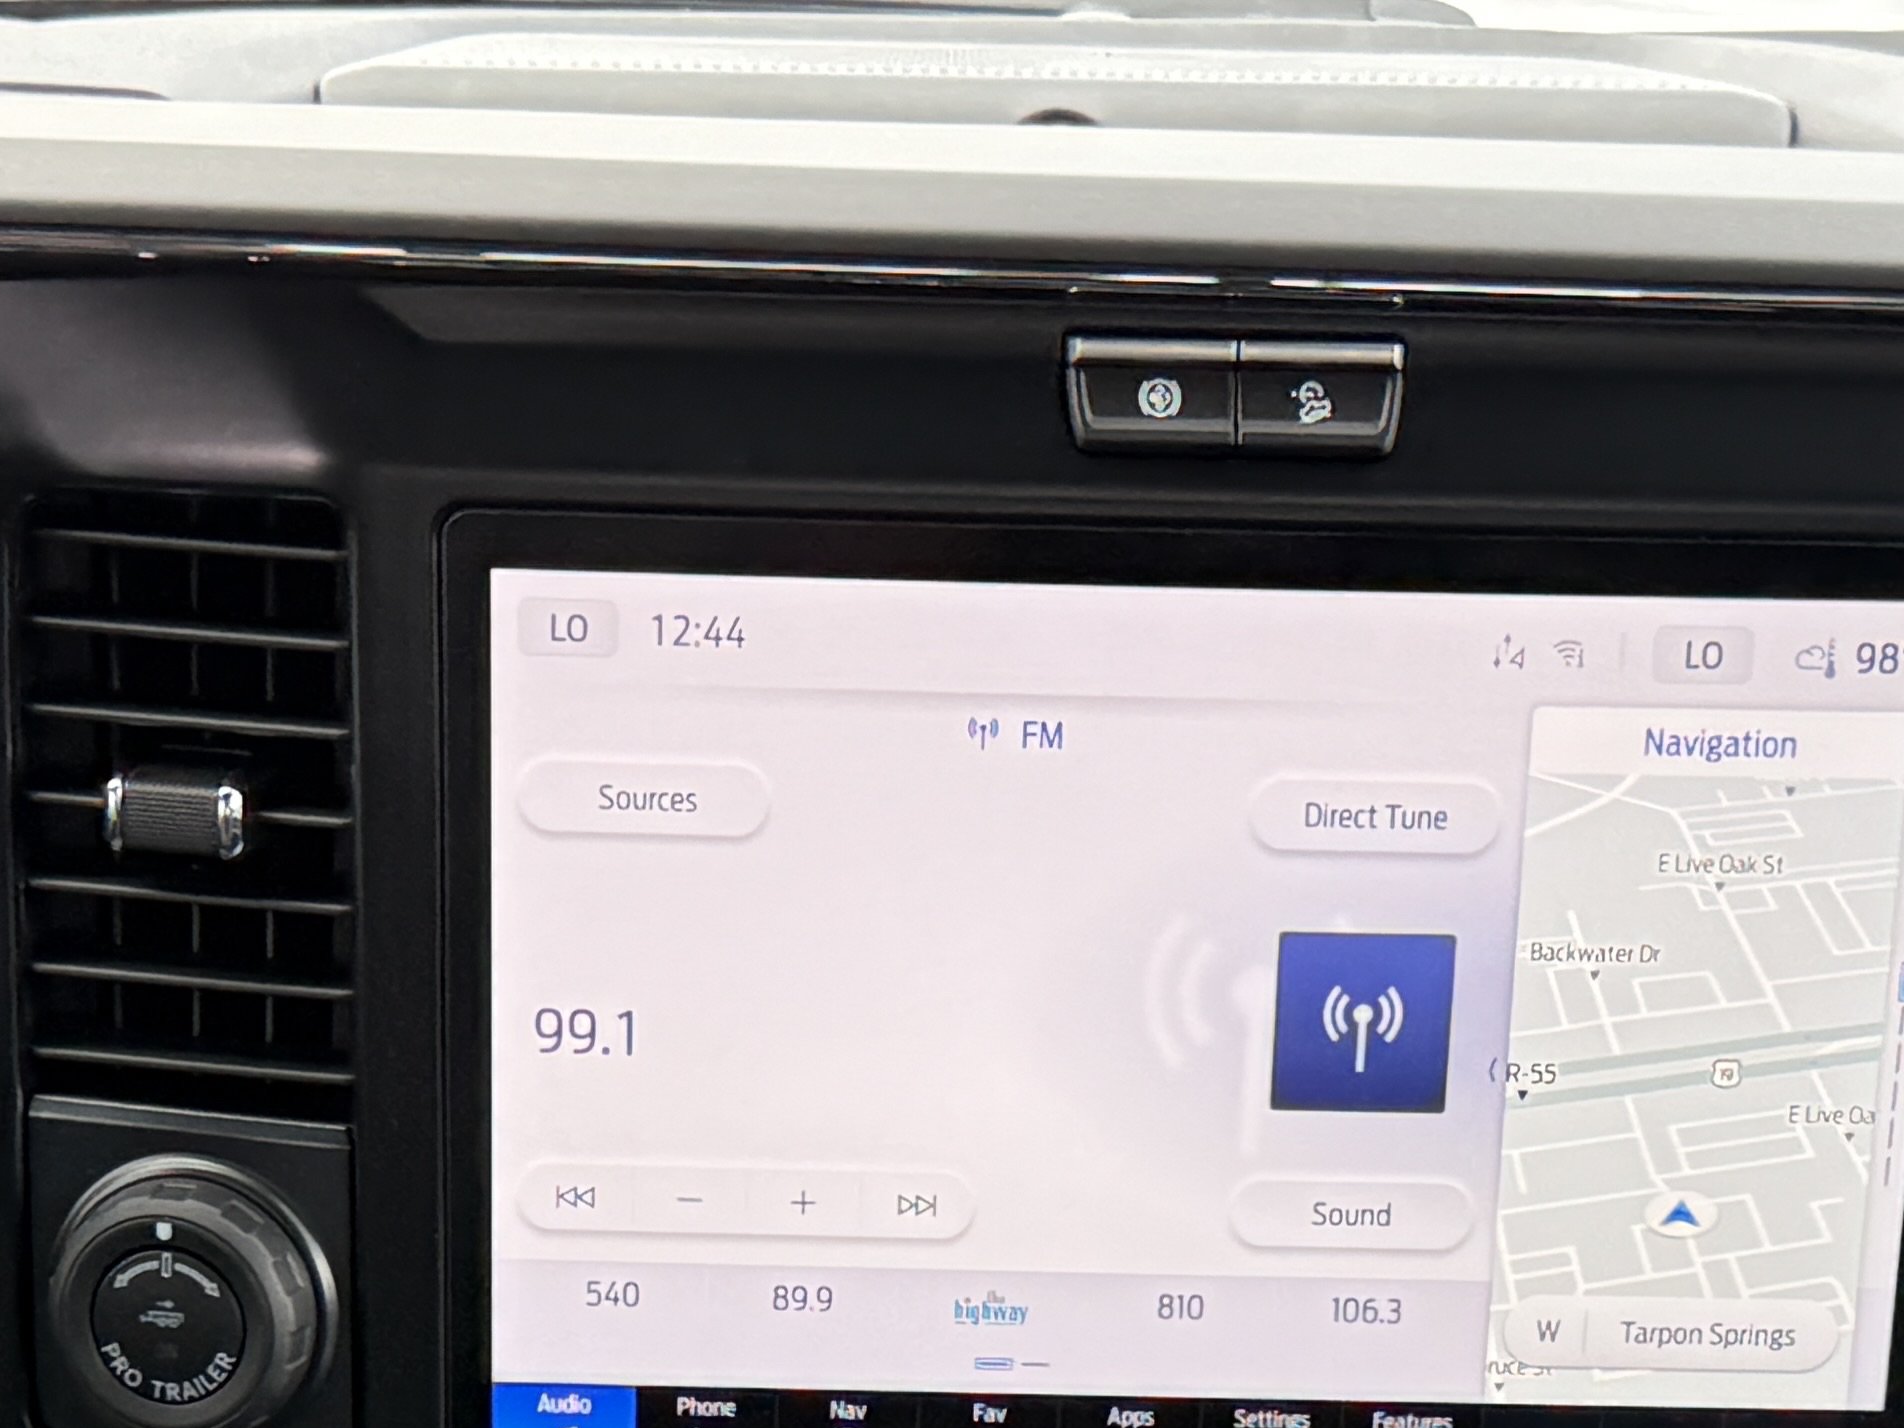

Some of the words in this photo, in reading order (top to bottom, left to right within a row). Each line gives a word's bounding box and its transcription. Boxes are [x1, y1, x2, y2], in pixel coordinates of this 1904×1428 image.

[550, 613, 588, 642] LO
[651, 614, 747, 649] 12:44
[1684, 641, 1724, 671] LO
[1022, 721, 1065, 751] FM
[1644, 728, 1798, 763] Navigation
[598, 784, 698, 815] Sources
[1304, 801, 1378, 831] Direct
[1385, 803, 1449, 833] Tune
[1658, 853, 1670, 873] E
[1675, 854, 1715, 875] Live
[1718, 854, 1758, 875] Oak
[1763, 855, 1784, 875] St
[1530, 942, 1633, 964] Backwater
[1640, 944, 1661, 964] Dr
[534, 1008, 637, 1057] 99.1
[1789, 1105, 1800, 1124] E
[1805, 1105, 1844, 1124] Live
[1312, 1200, 1392, 1228] Sound
[585, 1280, 640, 1308] 540
[771, 1285, 834, 1313] 89.9
[1157, 1294, 1204, 1321] 810
[954, 1297, 1028, 1325] highway
[1331, 1297, 1402, 1325] 106.3
[1537, 1320, 1561, 1342] W
[1620, 1321, 1702, 1349] Tarpon
[1709, 1322, 1796, 1351] Springs
[100, 1342, 143, 1387] PRO
[151, 1351, 237, 1402] TRAILER
[537, 1392, 592, 1416] Audio
[676, 1395, 737, 1420] Phone
[830, 1400, 867, 1422] Nav
[973, 1403, 1007, 1424] Fav
[1107, 1407, 1155, 1428] Apps
